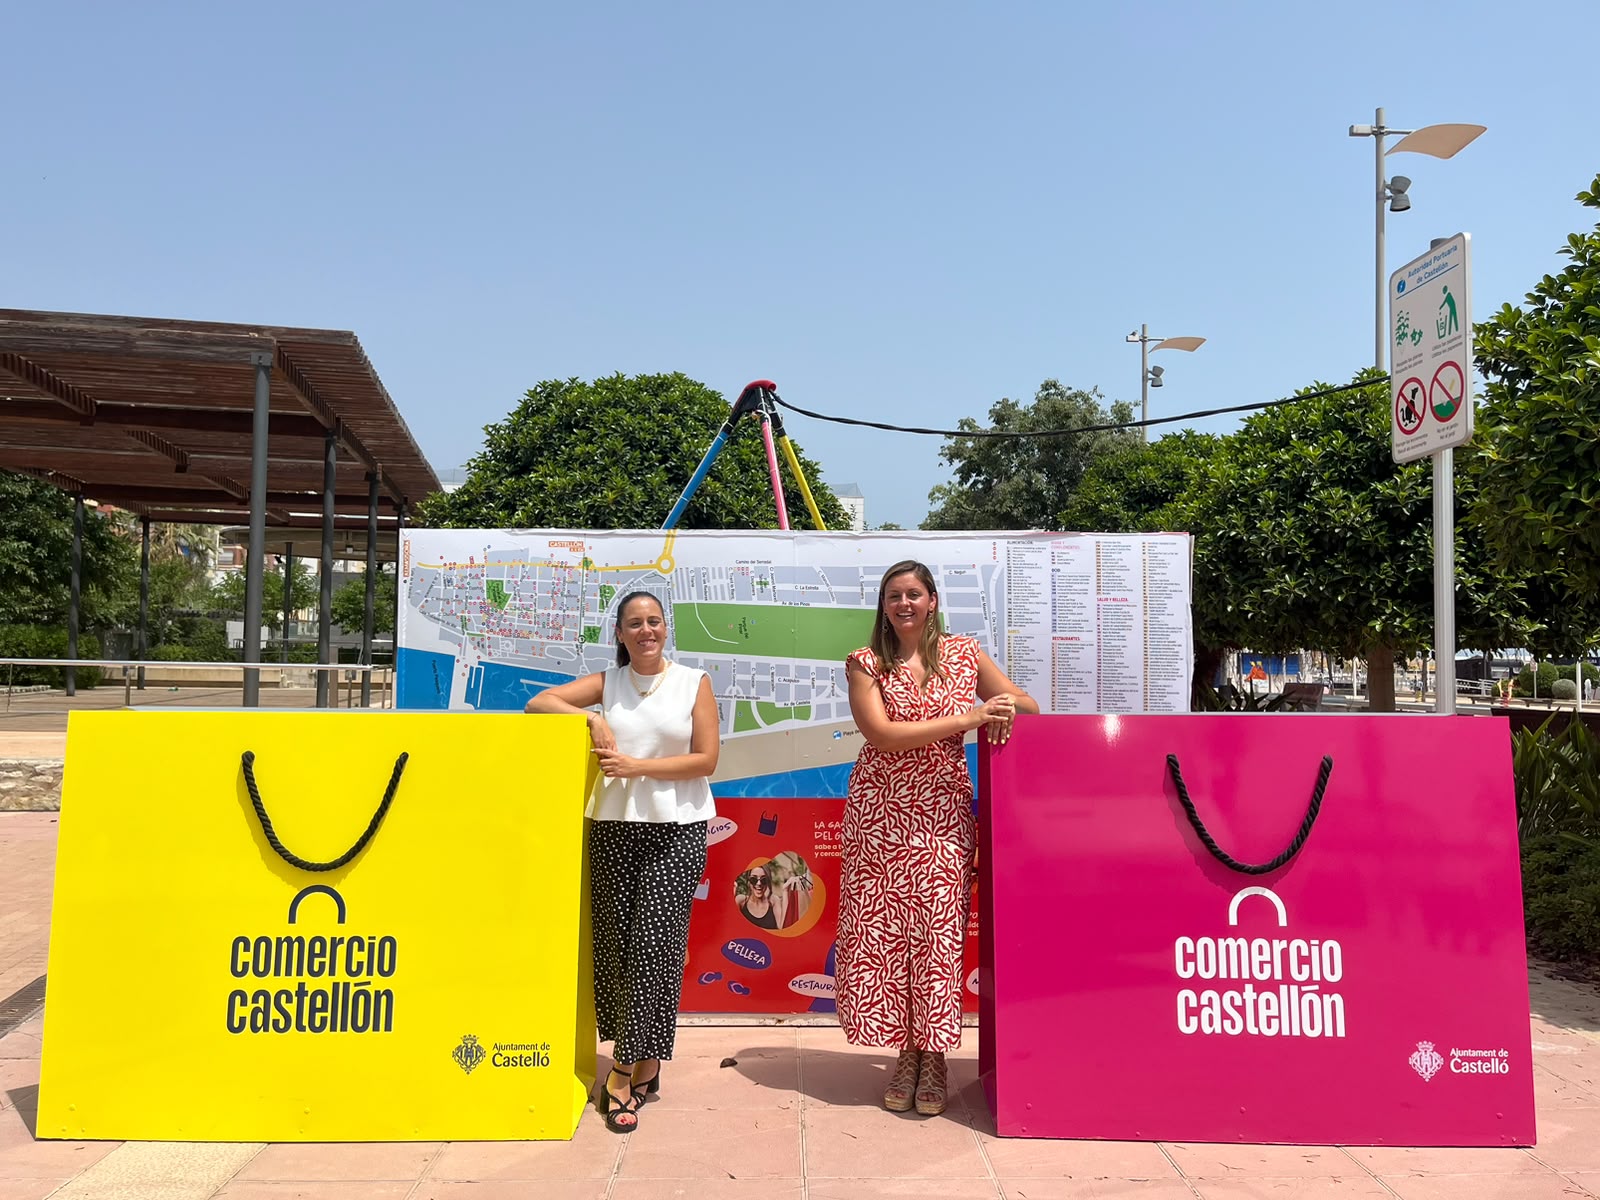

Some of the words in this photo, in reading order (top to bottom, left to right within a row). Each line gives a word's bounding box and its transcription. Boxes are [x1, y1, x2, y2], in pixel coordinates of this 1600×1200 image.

[1408, 259, 1432, 278] Autoridad
[1433, 245, 1457, 263] Portuaria
[1424, 262, 1448, 279] Castellón
[815, 821, 825, 830] LA
[828, 821, 842, 830] GA
[814, 831, 833, 840] DEL
[835, 832, 841, 840] G
[230, 936, 397, 978] comercio
[728, 941, 765, 965] BELLEZA
[1175, 936, 1342, 982] comercio
[226, 981, 394, 1033] castellón
[1177, 984, 1346, 1038] castellón
[493, 1043, 538, 1052] Ajuntament
[540, 1042, 550, 1050] de
[1450, 1048, 1496, 1059] Ajuntament
[1498, 1048, 1508, 1057] de
[492, 1052, 550, 1067] Castelló
[1450, 1058, 1509, 1074] Castelló
